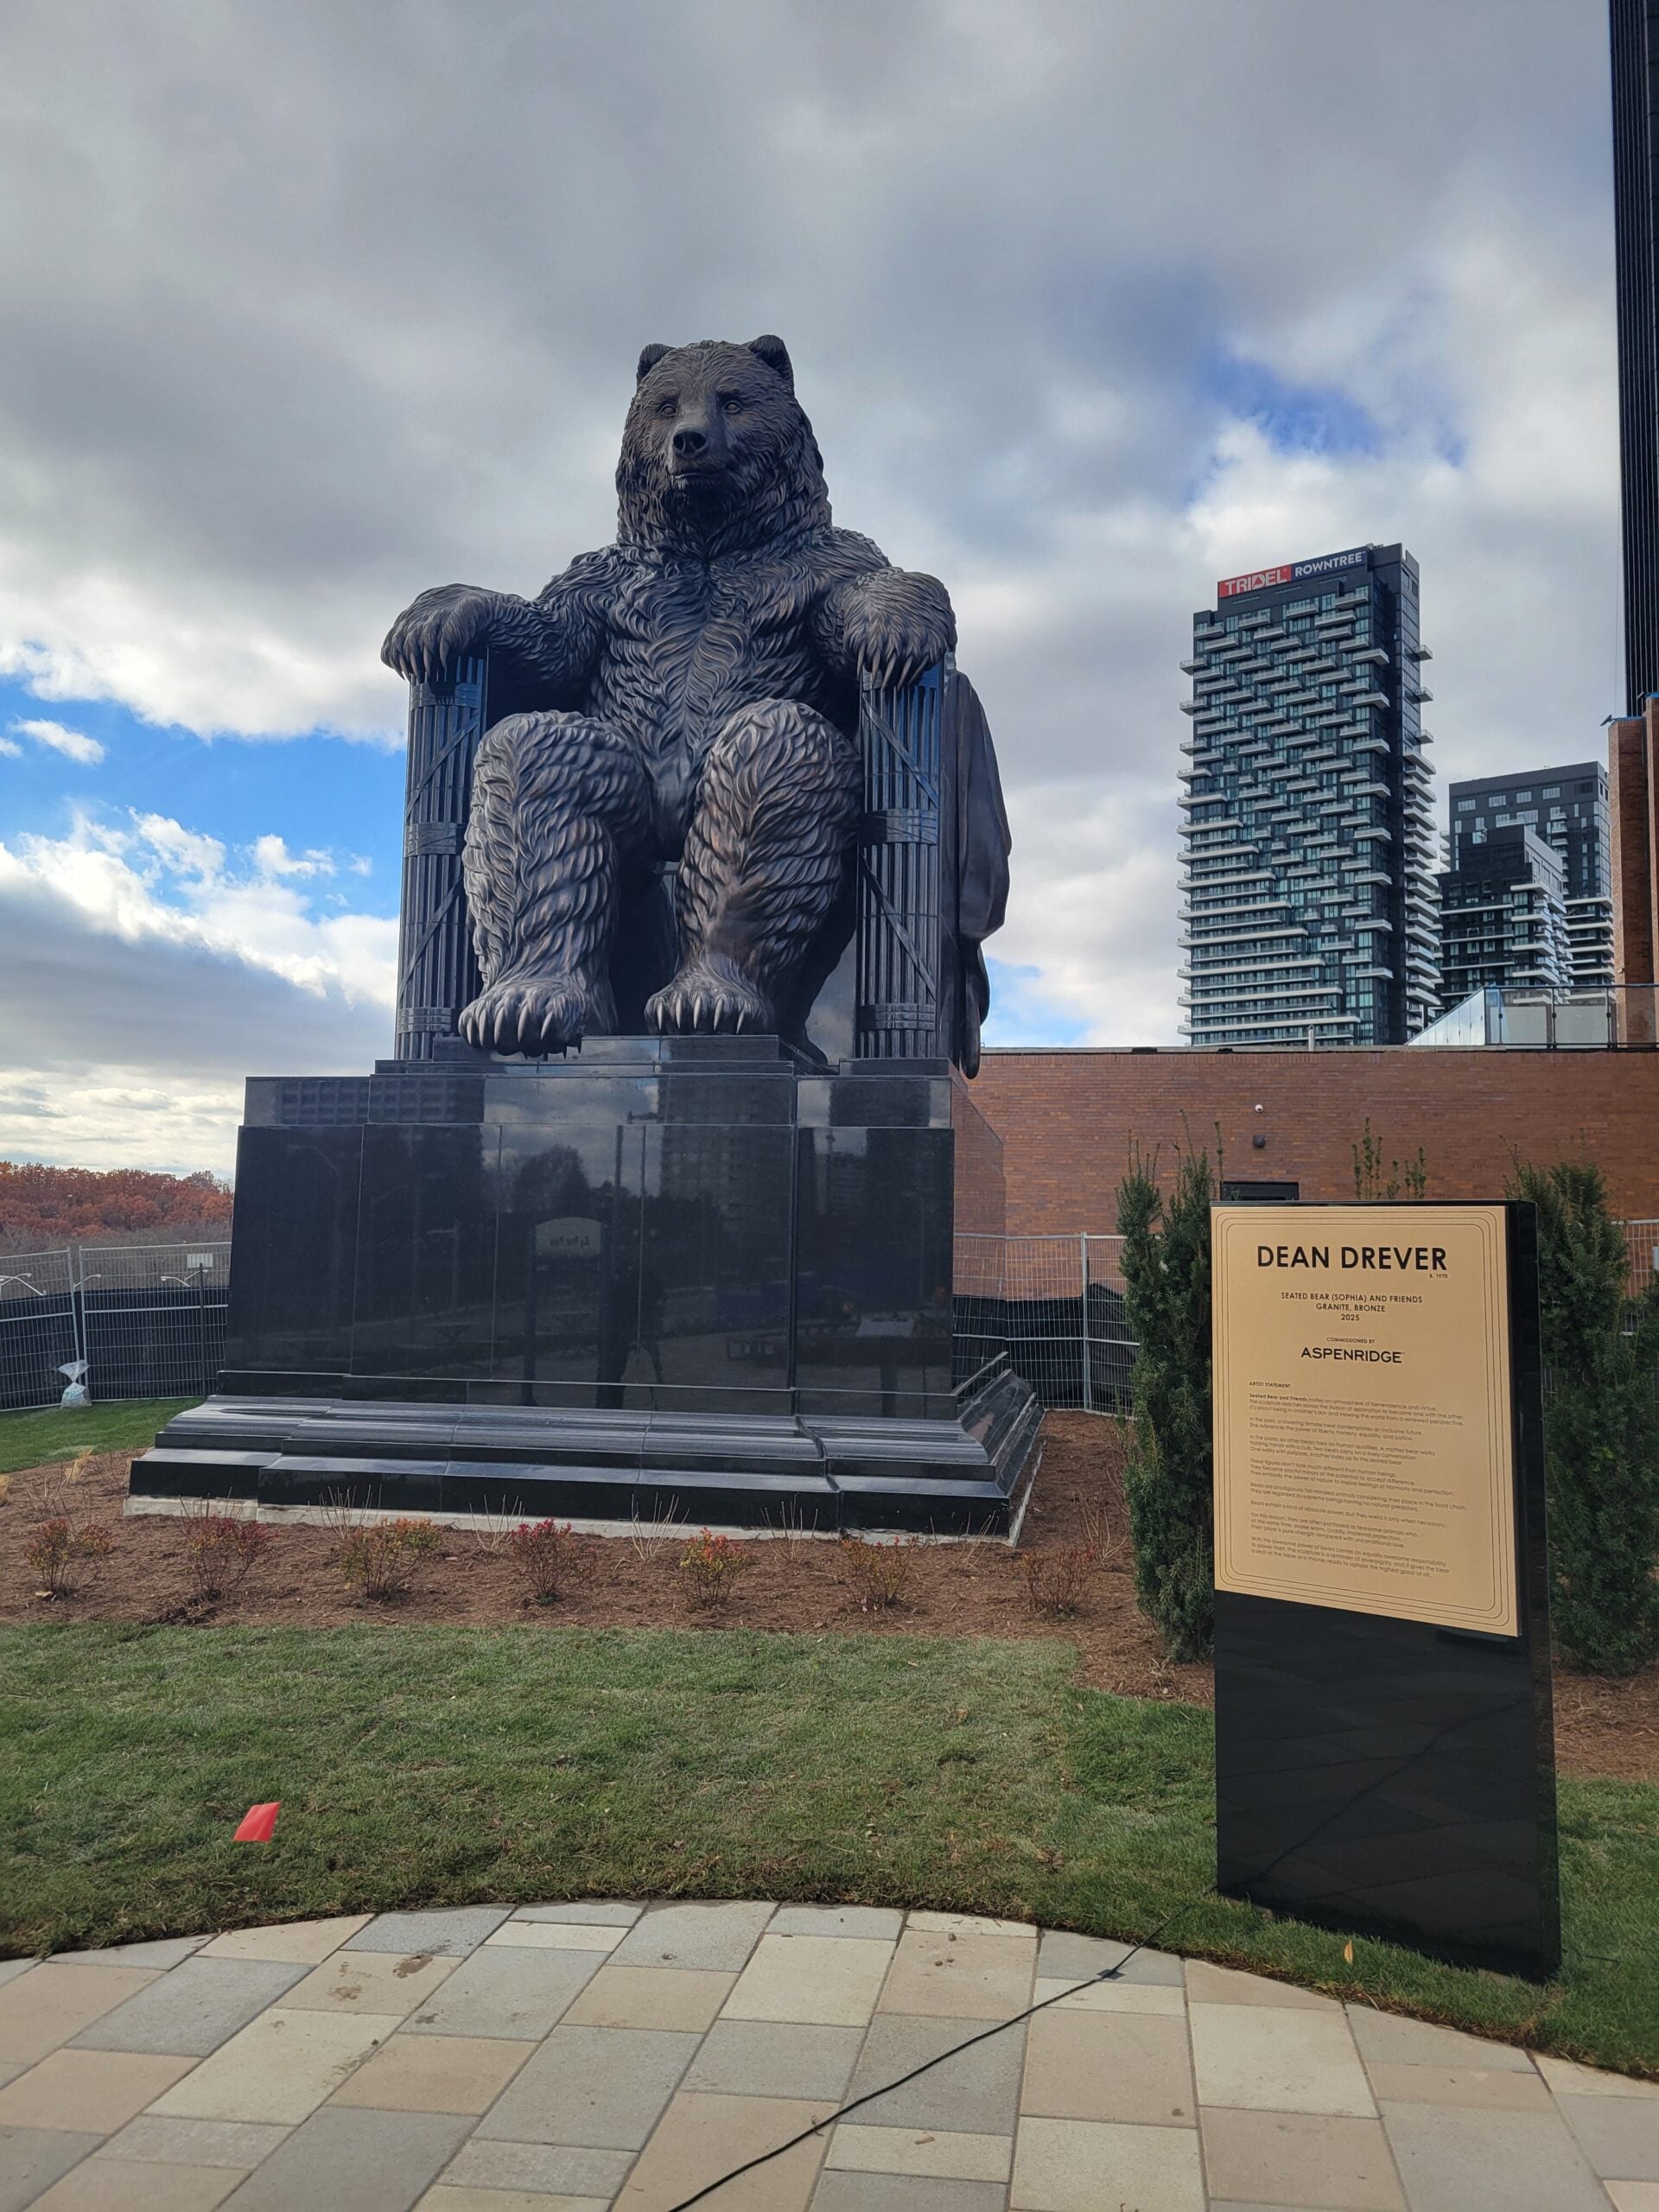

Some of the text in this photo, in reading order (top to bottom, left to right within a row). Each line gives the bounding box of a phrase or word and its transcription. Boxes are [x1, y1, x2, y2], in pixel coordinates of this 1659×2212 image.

[1294, 551, 1363, 577] ROWNTREE
[1224, 569, 1287, 594] TRIDEL
[1257, 1245, 1447, 1270] DEAN DREVER
[1316, 1303, 1386, 1313] GRANITE, BRONZE
[1332, 1294, 1366, 1303] (SOPHIA)
[1389, 1295, 1423, 1304] FRIENDS
[1300, 1347, 1402, 1363] ASPENRIDGE
